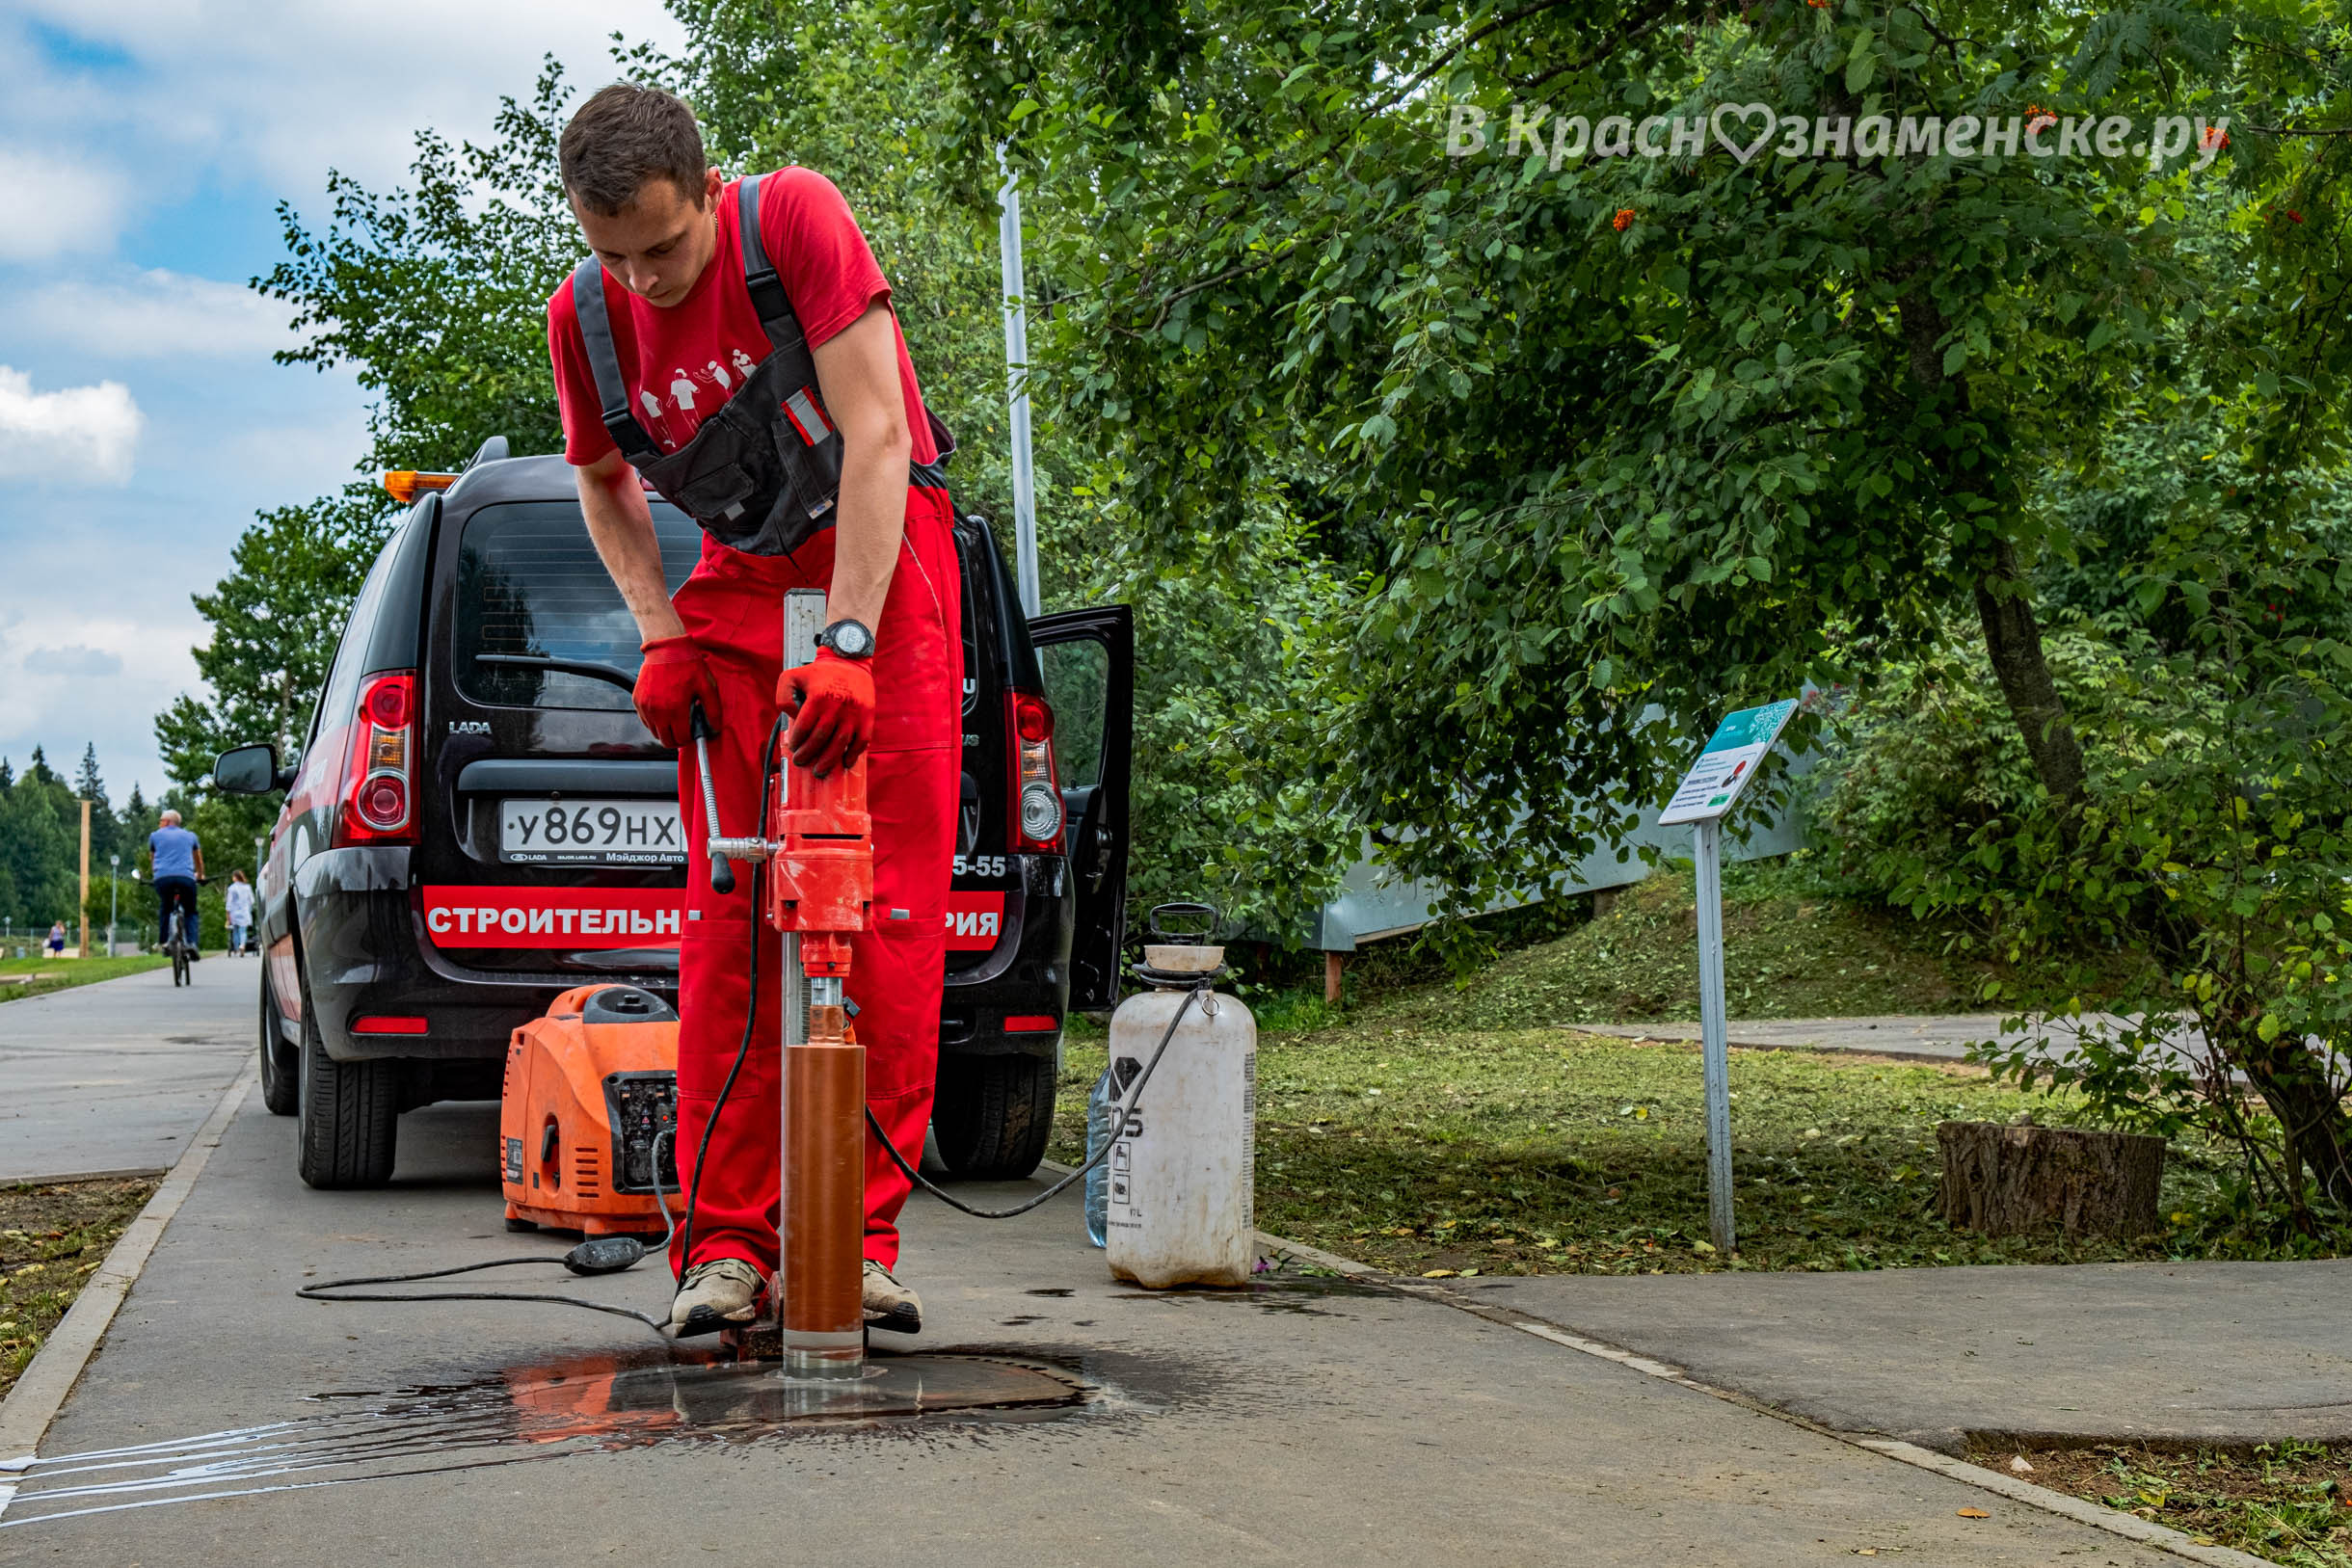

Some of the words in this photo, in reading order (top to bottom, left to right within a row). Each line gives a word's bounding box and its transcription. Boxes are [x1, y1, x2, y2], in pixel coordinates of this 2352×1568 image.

[448, 721, 493, 734] LADA
[605, 852, 657, 864] Мэйджор
[659, 853, 684, 864] Авто
[427, 907, 682, 934] СТРОИТЕЛЬН
